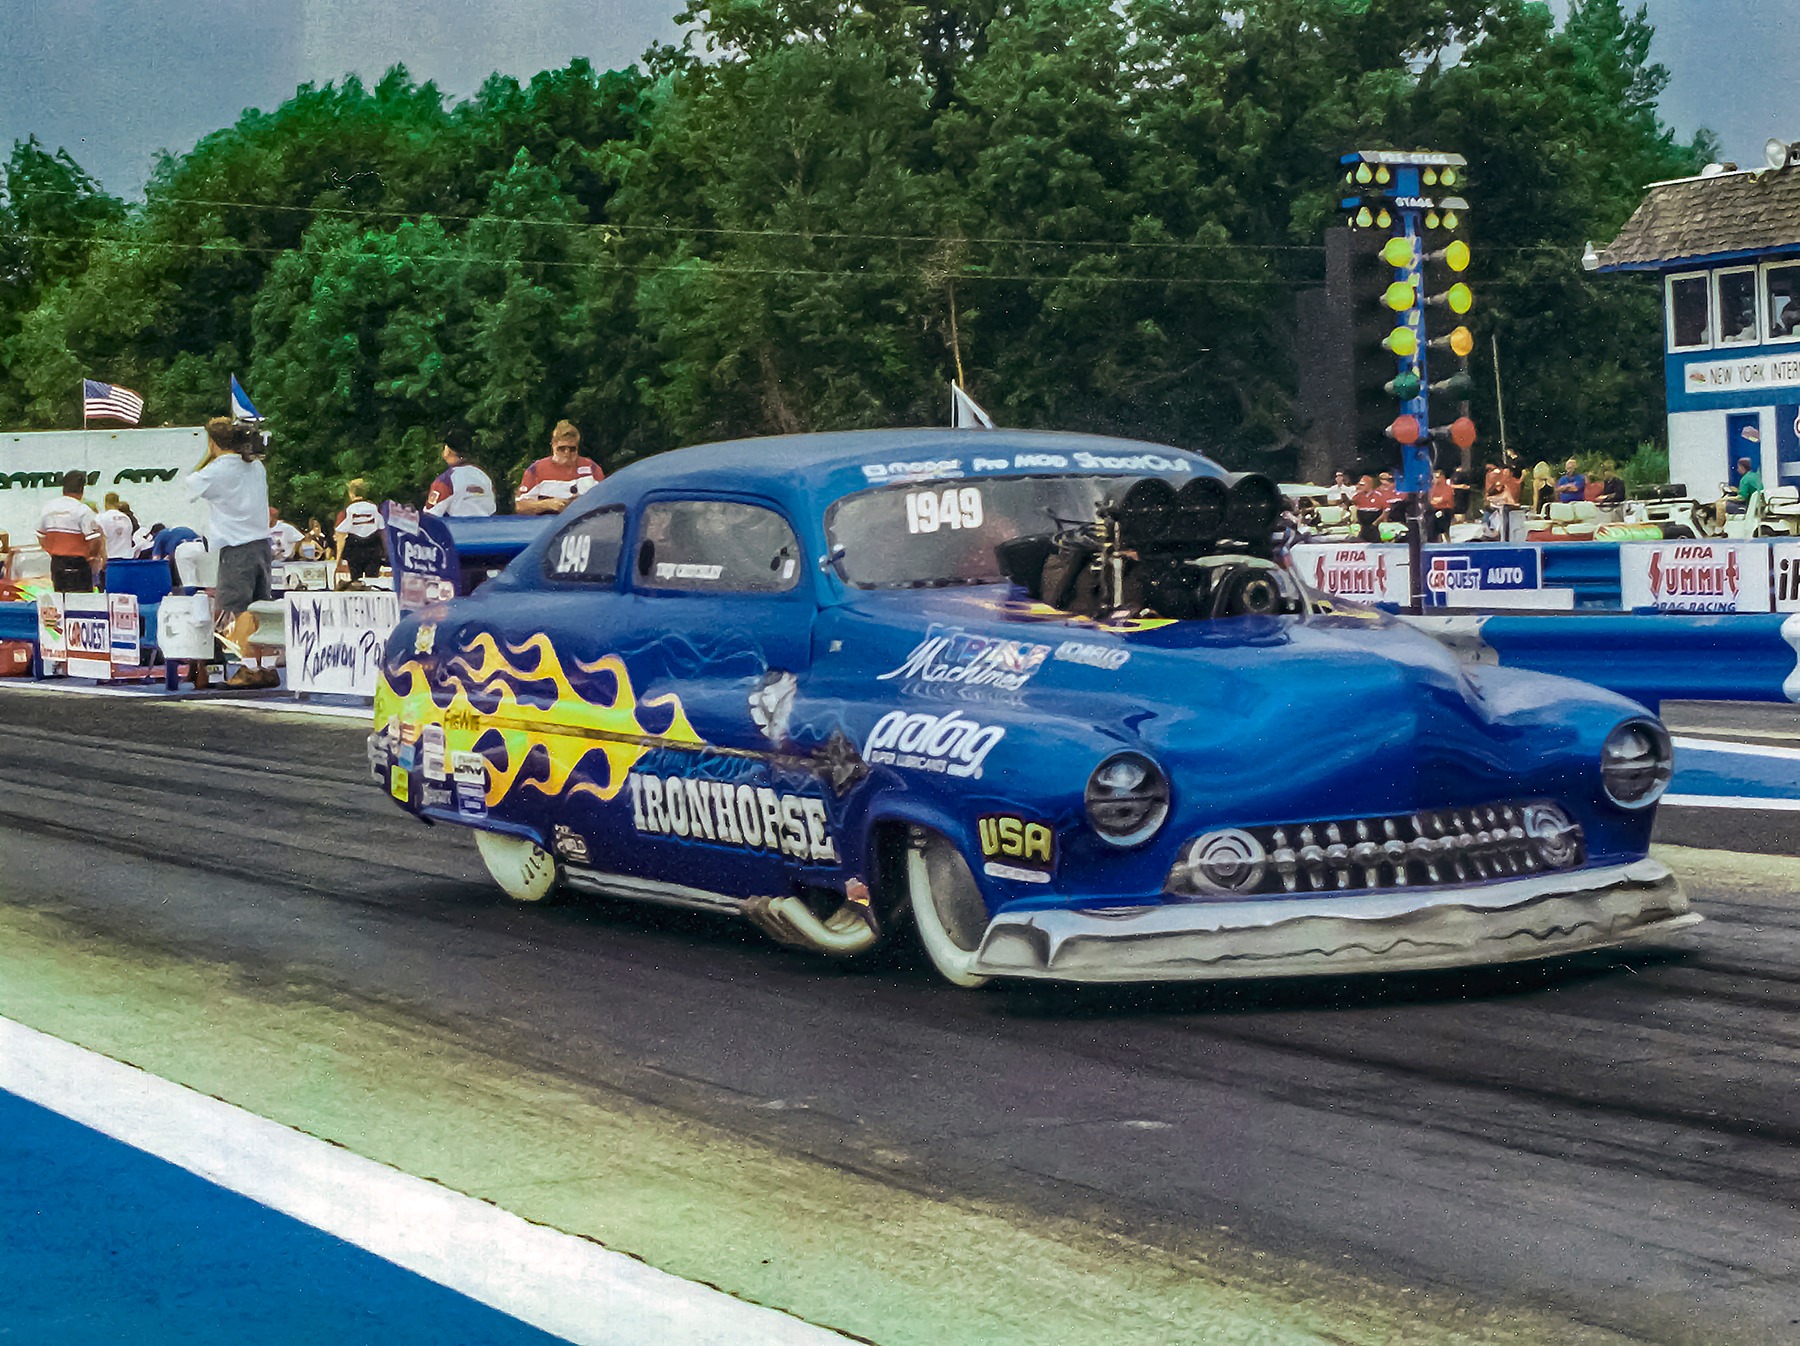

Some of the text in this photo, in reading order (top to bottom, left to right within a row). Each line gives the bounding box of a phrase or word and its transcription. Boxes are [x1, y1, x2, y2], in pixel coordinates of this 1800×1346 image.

[1710, 367, 1733, 385] NEW
[1738, 363, 1764, 382] YORK
[906, 487, 983, 534] 1949
[1336, 551, 1366, 561] IHRA
[1674, 546, 1713, 560] IHRA
[1428, 567, 1524, 589] CARQUEST AUTO
[300, 630, 387, 687] Raceway Pa
[877, 636, 1031, 691] Machines
[629, 772, 842, 863] IRONHORSE
[979, 817, 1051, 861] USA
